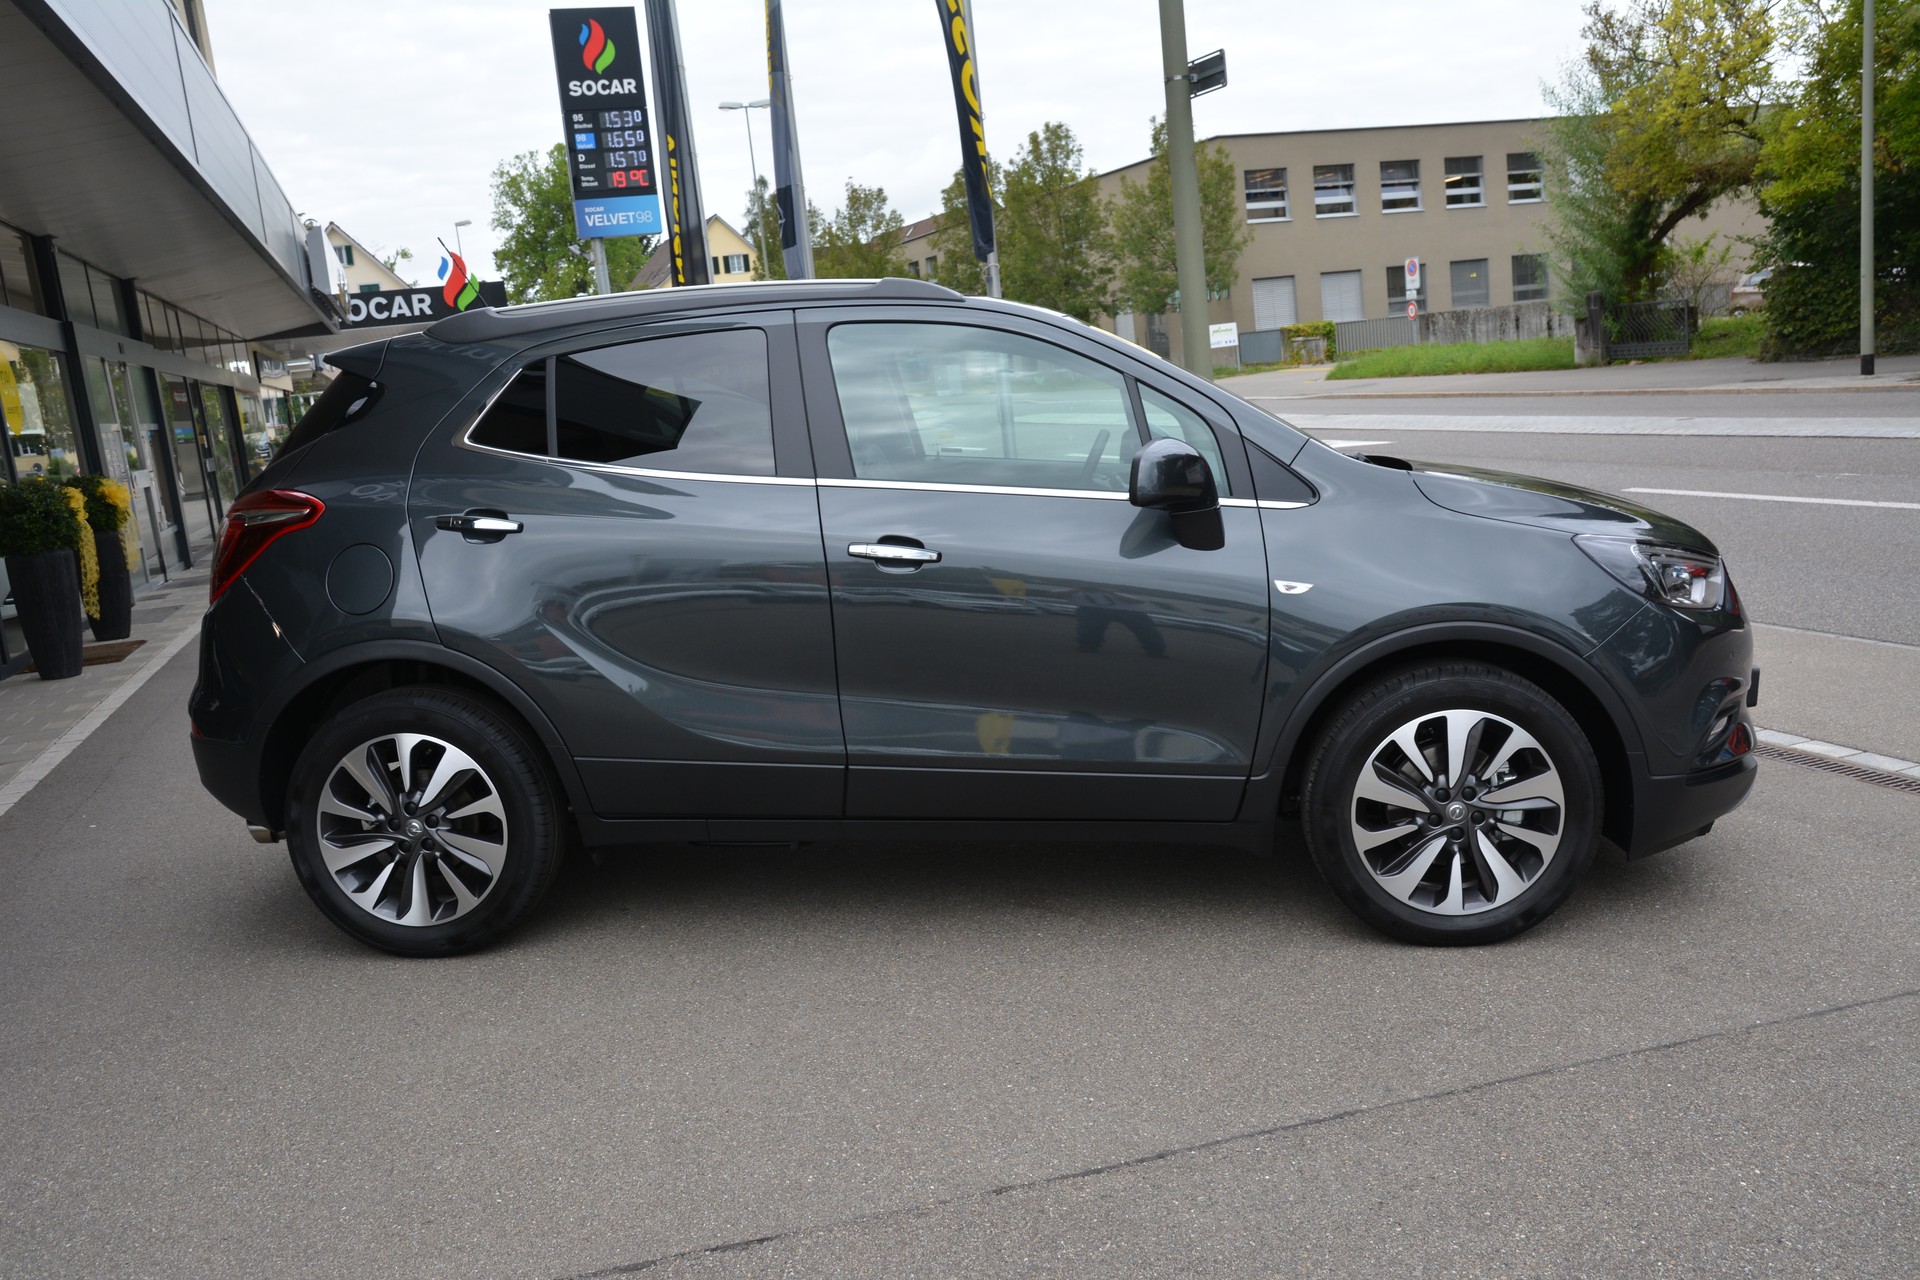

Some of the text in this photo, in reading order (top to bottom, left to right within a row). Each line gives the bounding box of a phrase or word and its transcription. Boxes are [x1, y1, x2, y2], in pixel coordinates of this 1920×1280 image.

[568, 78, 637, 97] SOCAR
[572, 113, 584, 122] 95
[575, 133, 587, 142] 98
[578, 154, 586, 162] D
[612, 170, 627, 188] 19
[349, 293, 433, 322] OCAR
